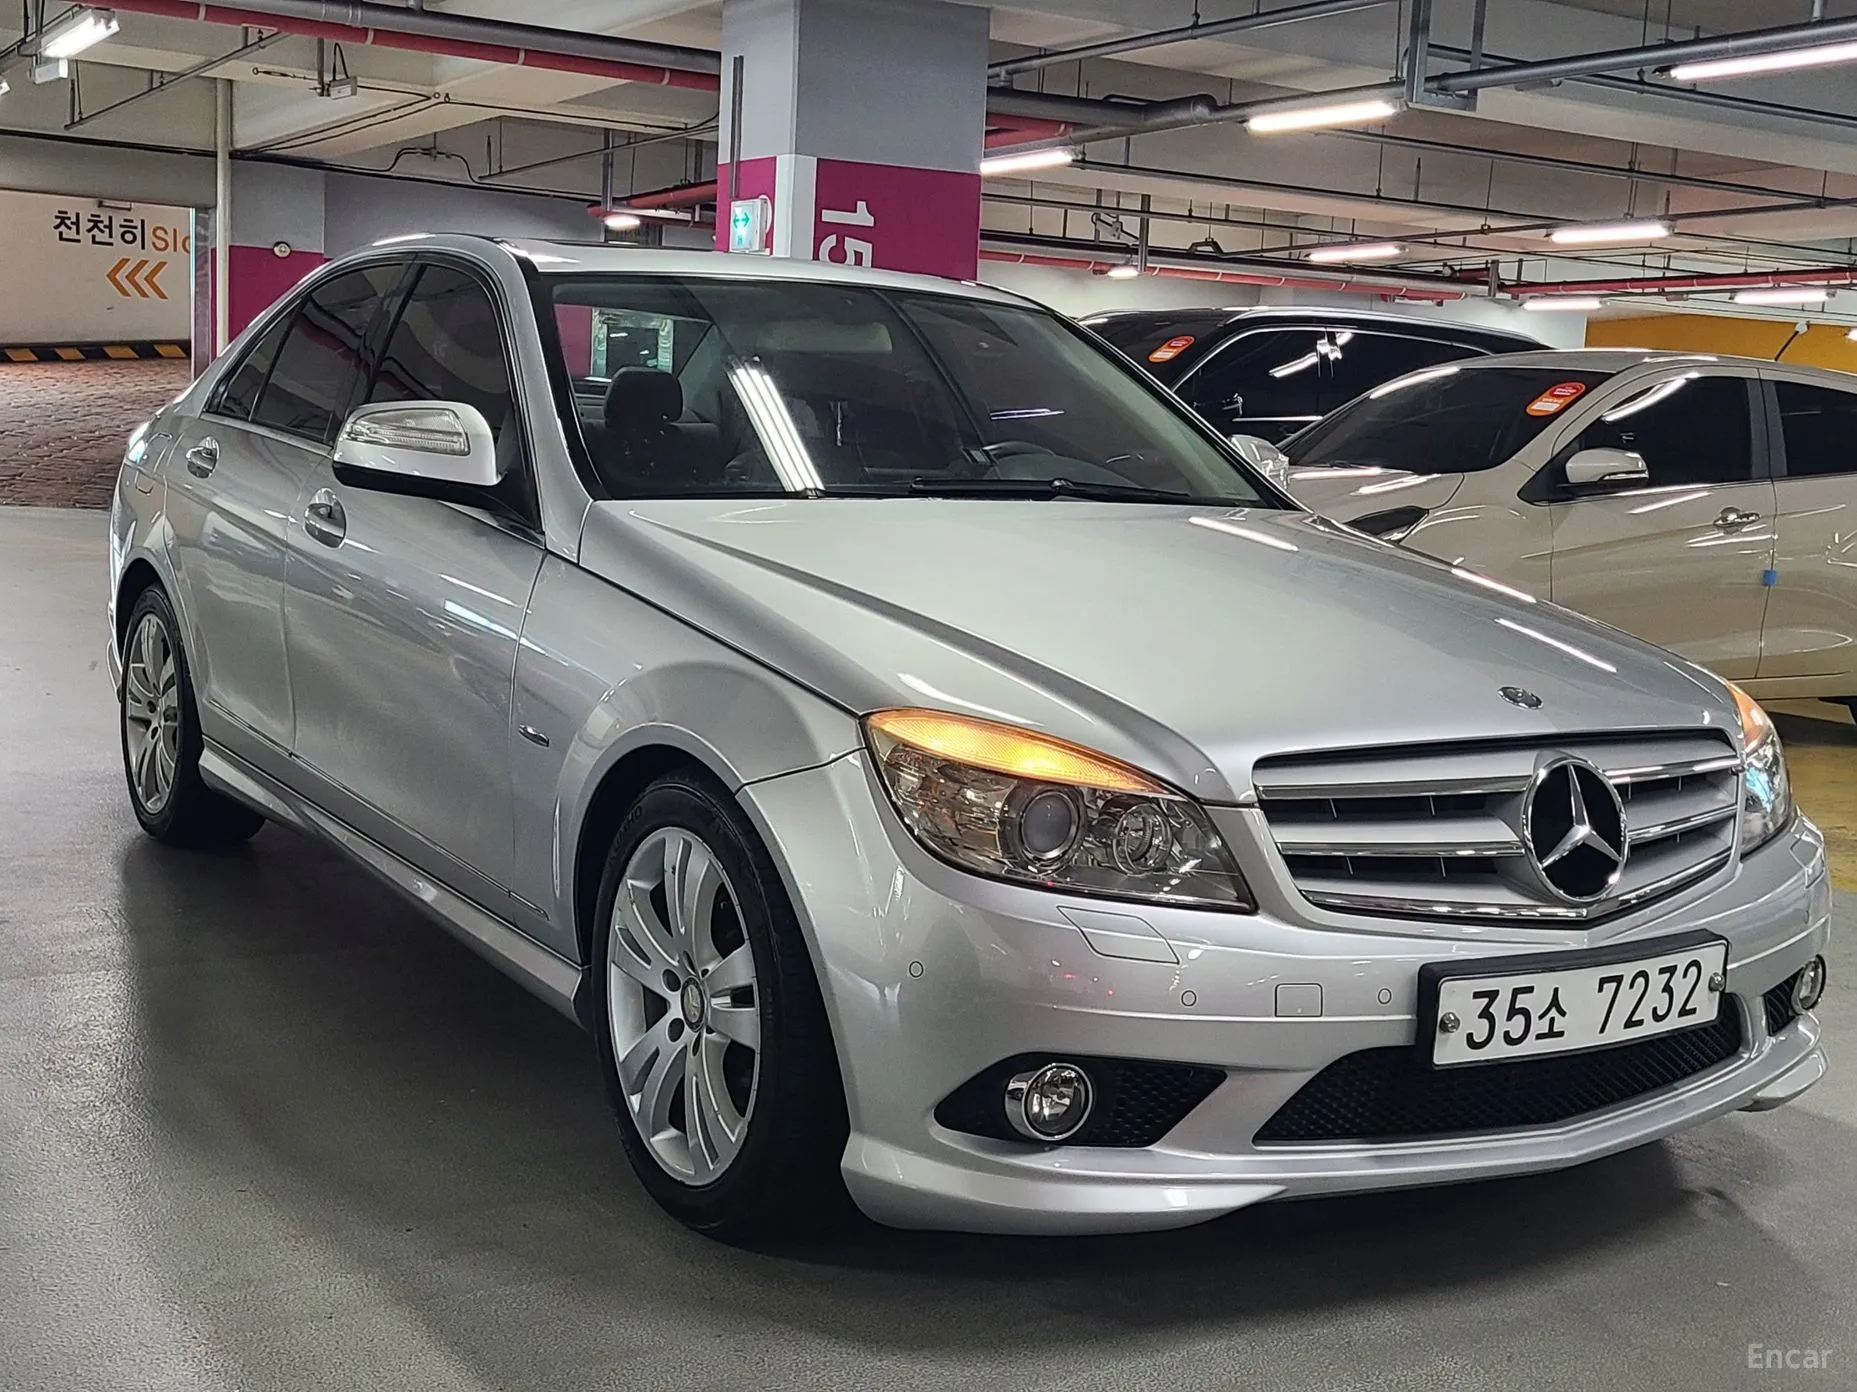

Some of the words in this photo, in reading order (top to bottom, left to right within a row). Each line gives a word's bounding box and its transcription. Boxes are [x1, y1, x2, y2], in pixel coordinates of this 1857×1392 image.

[53, 209, 146, 250] 천천히
[1465, 985, 1567, 1050] 35소
[1597, 959, 1703, 1034] 7232
